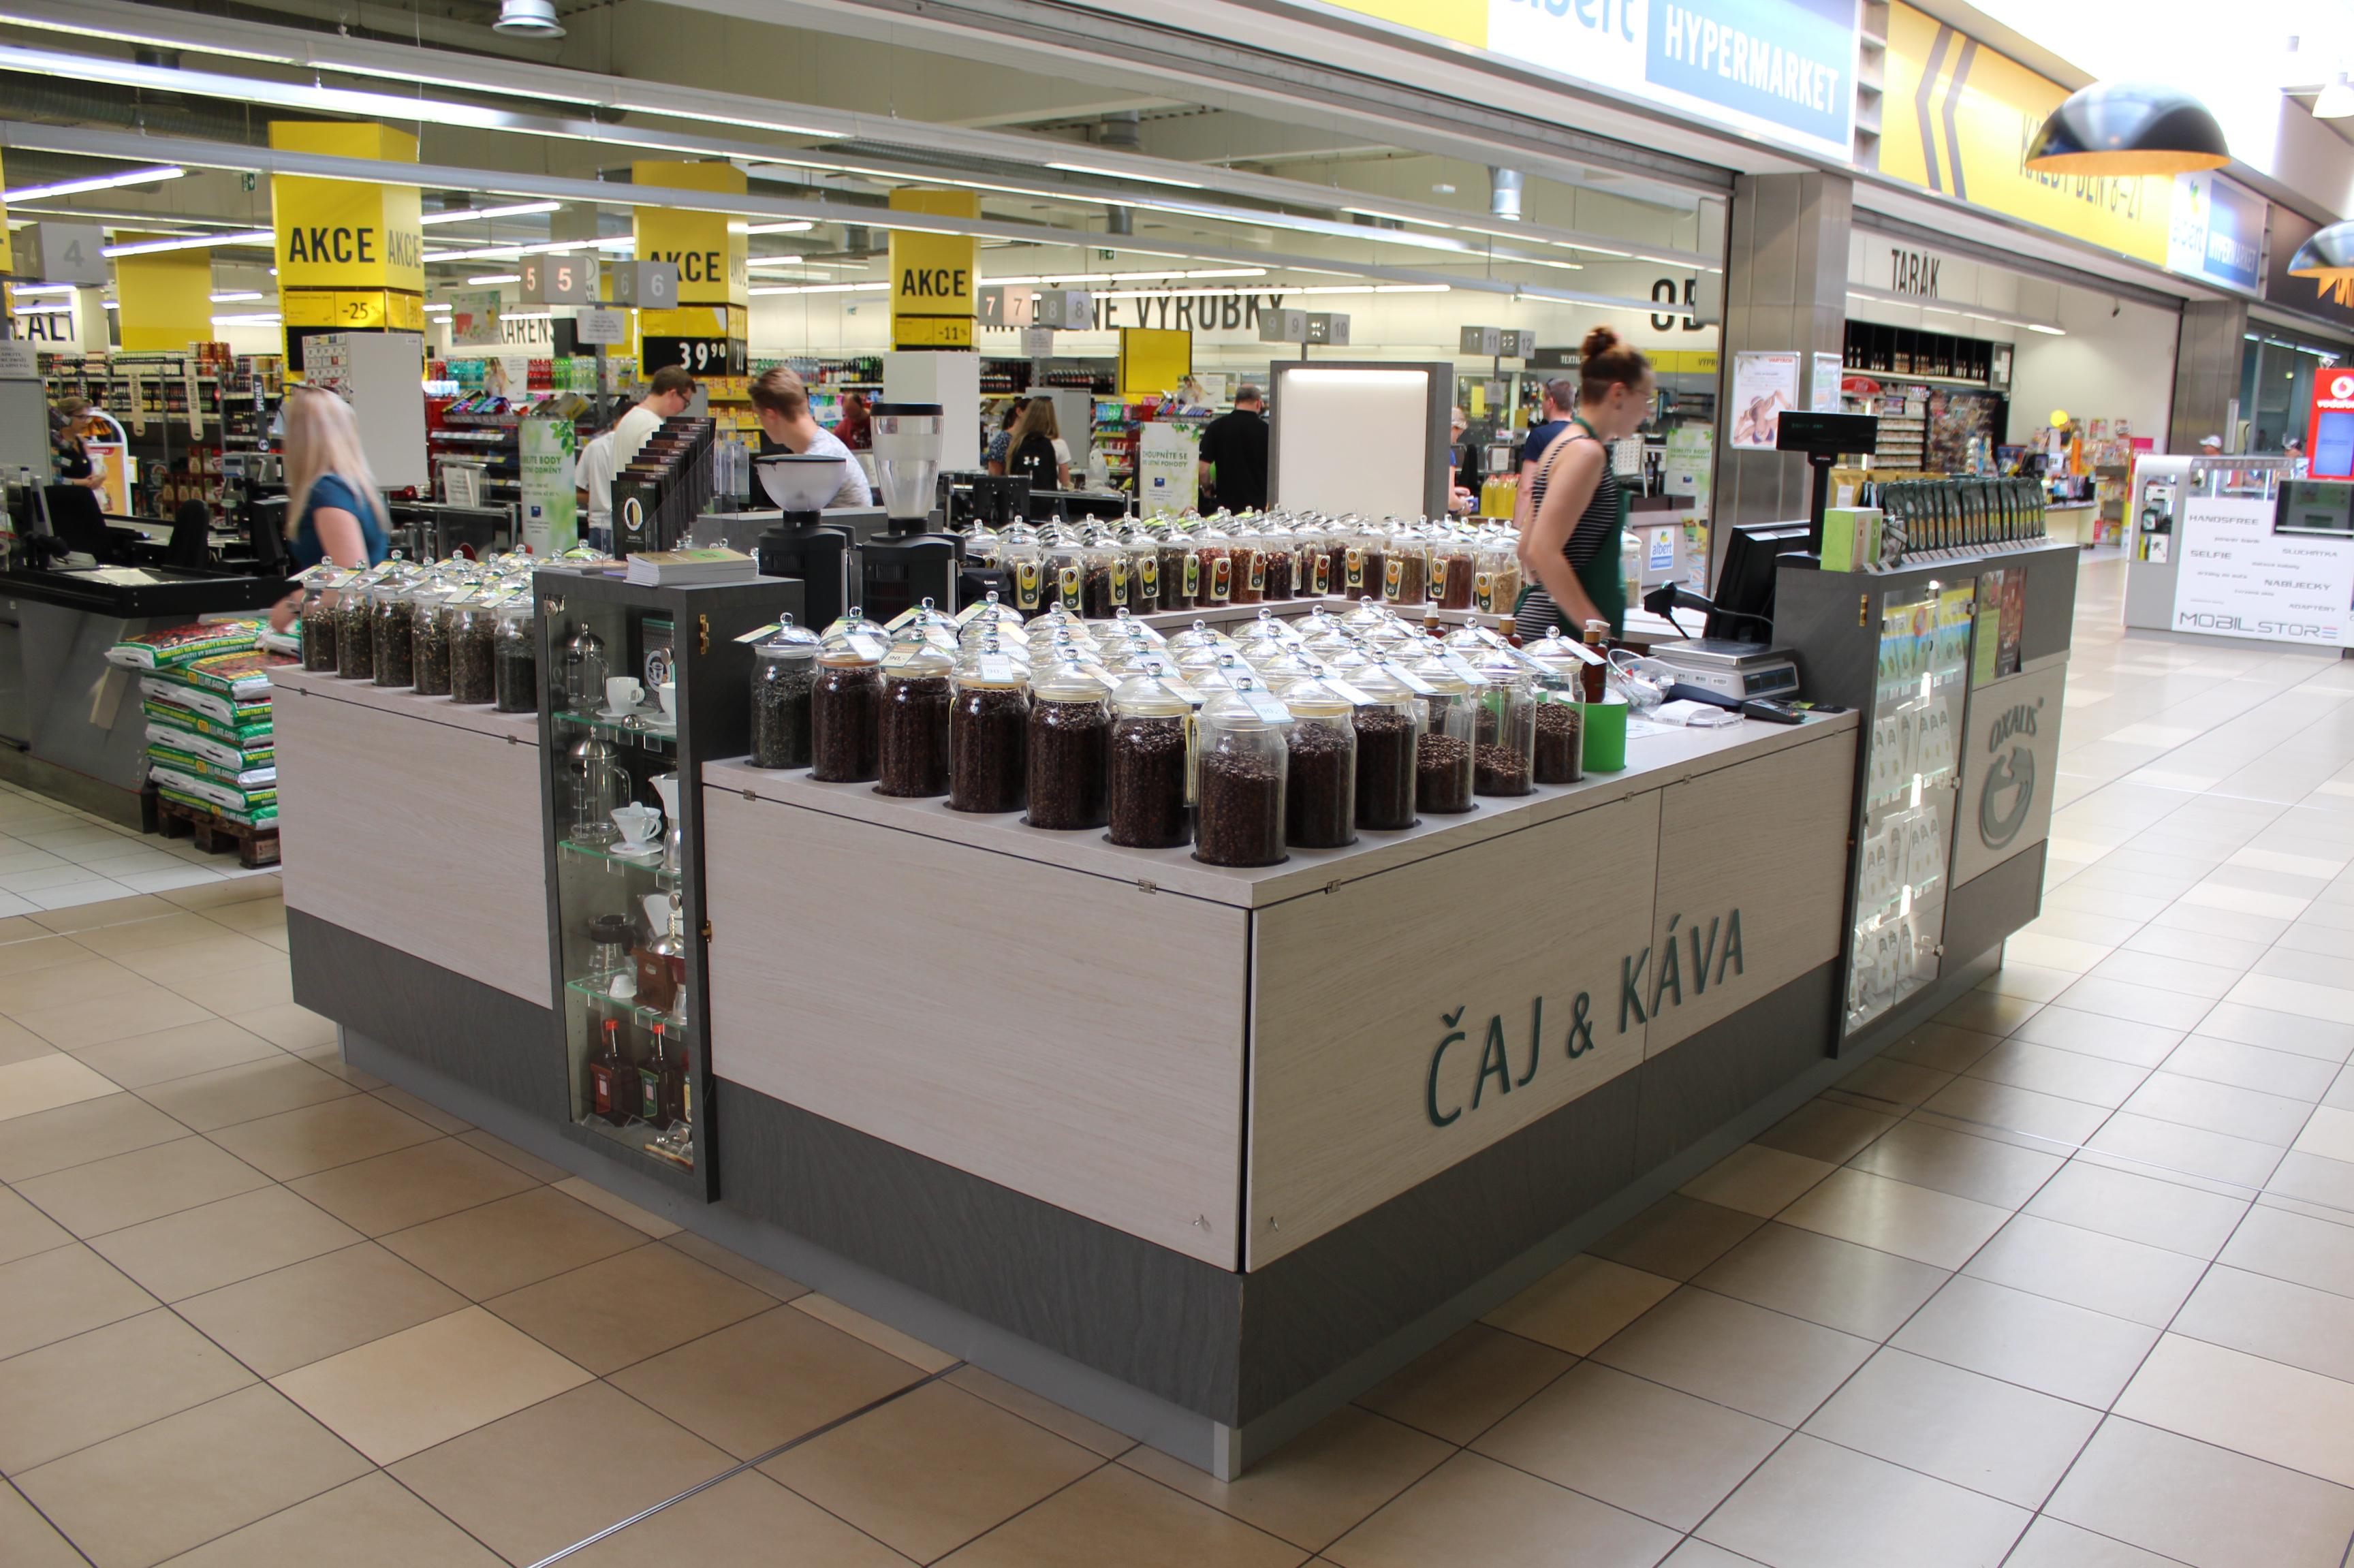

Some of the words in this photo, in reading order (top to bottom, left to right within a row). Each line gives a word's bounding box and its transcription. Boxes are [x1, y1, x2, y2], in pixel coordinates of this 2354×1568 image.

[1665, 3, 1840, 115] HYPERMARKET
[63, 239, 85, 267] 4
[289, 227, 376, 264] AKCE
[388, 230, 421, 269] AKCE
[527, 267, 536, 292] 5
[557, 267, 573, 292] 5
[621, 274, 630, 296] 6
[650, 274, 665, 297] 6
[901, 269, 967, 297] AKCE
[343, 302, 369, 320] -25
[986, 296, 996, 315] 7
[1014, 297, 1023, 317] 7
[1048, 300, 1058, 319] 8
[1075, 300, 1084, 319] 8
[1268, 317, 1277, 333] 9
[1292, 317, 1300, 334] 9
[1334, 322, 1348, 339] 10
[1488, 333, 1498, 349] 11
[1522, 334, 1533, 352] 12
[253, 381, 265, 412] SPECIÁLY
[539, 456, 563, 465] BODY
[2188, 515, 2260, 526] HANDSFREE
[1652, 542, 1672, 555] albert
[2190, 550, 2232, 560] SELFIE
[2179, 612, 2255, 633] MOBIL
[2257, 621, 2338, 640] STORE
[1988, 704, 2038, 753] OXALIS
[1428, 1005, 1543, 1128] ČAJ
[1567, 991, 1595, 1059] &
[1618, 908, 1744, 1034] KÁVA
